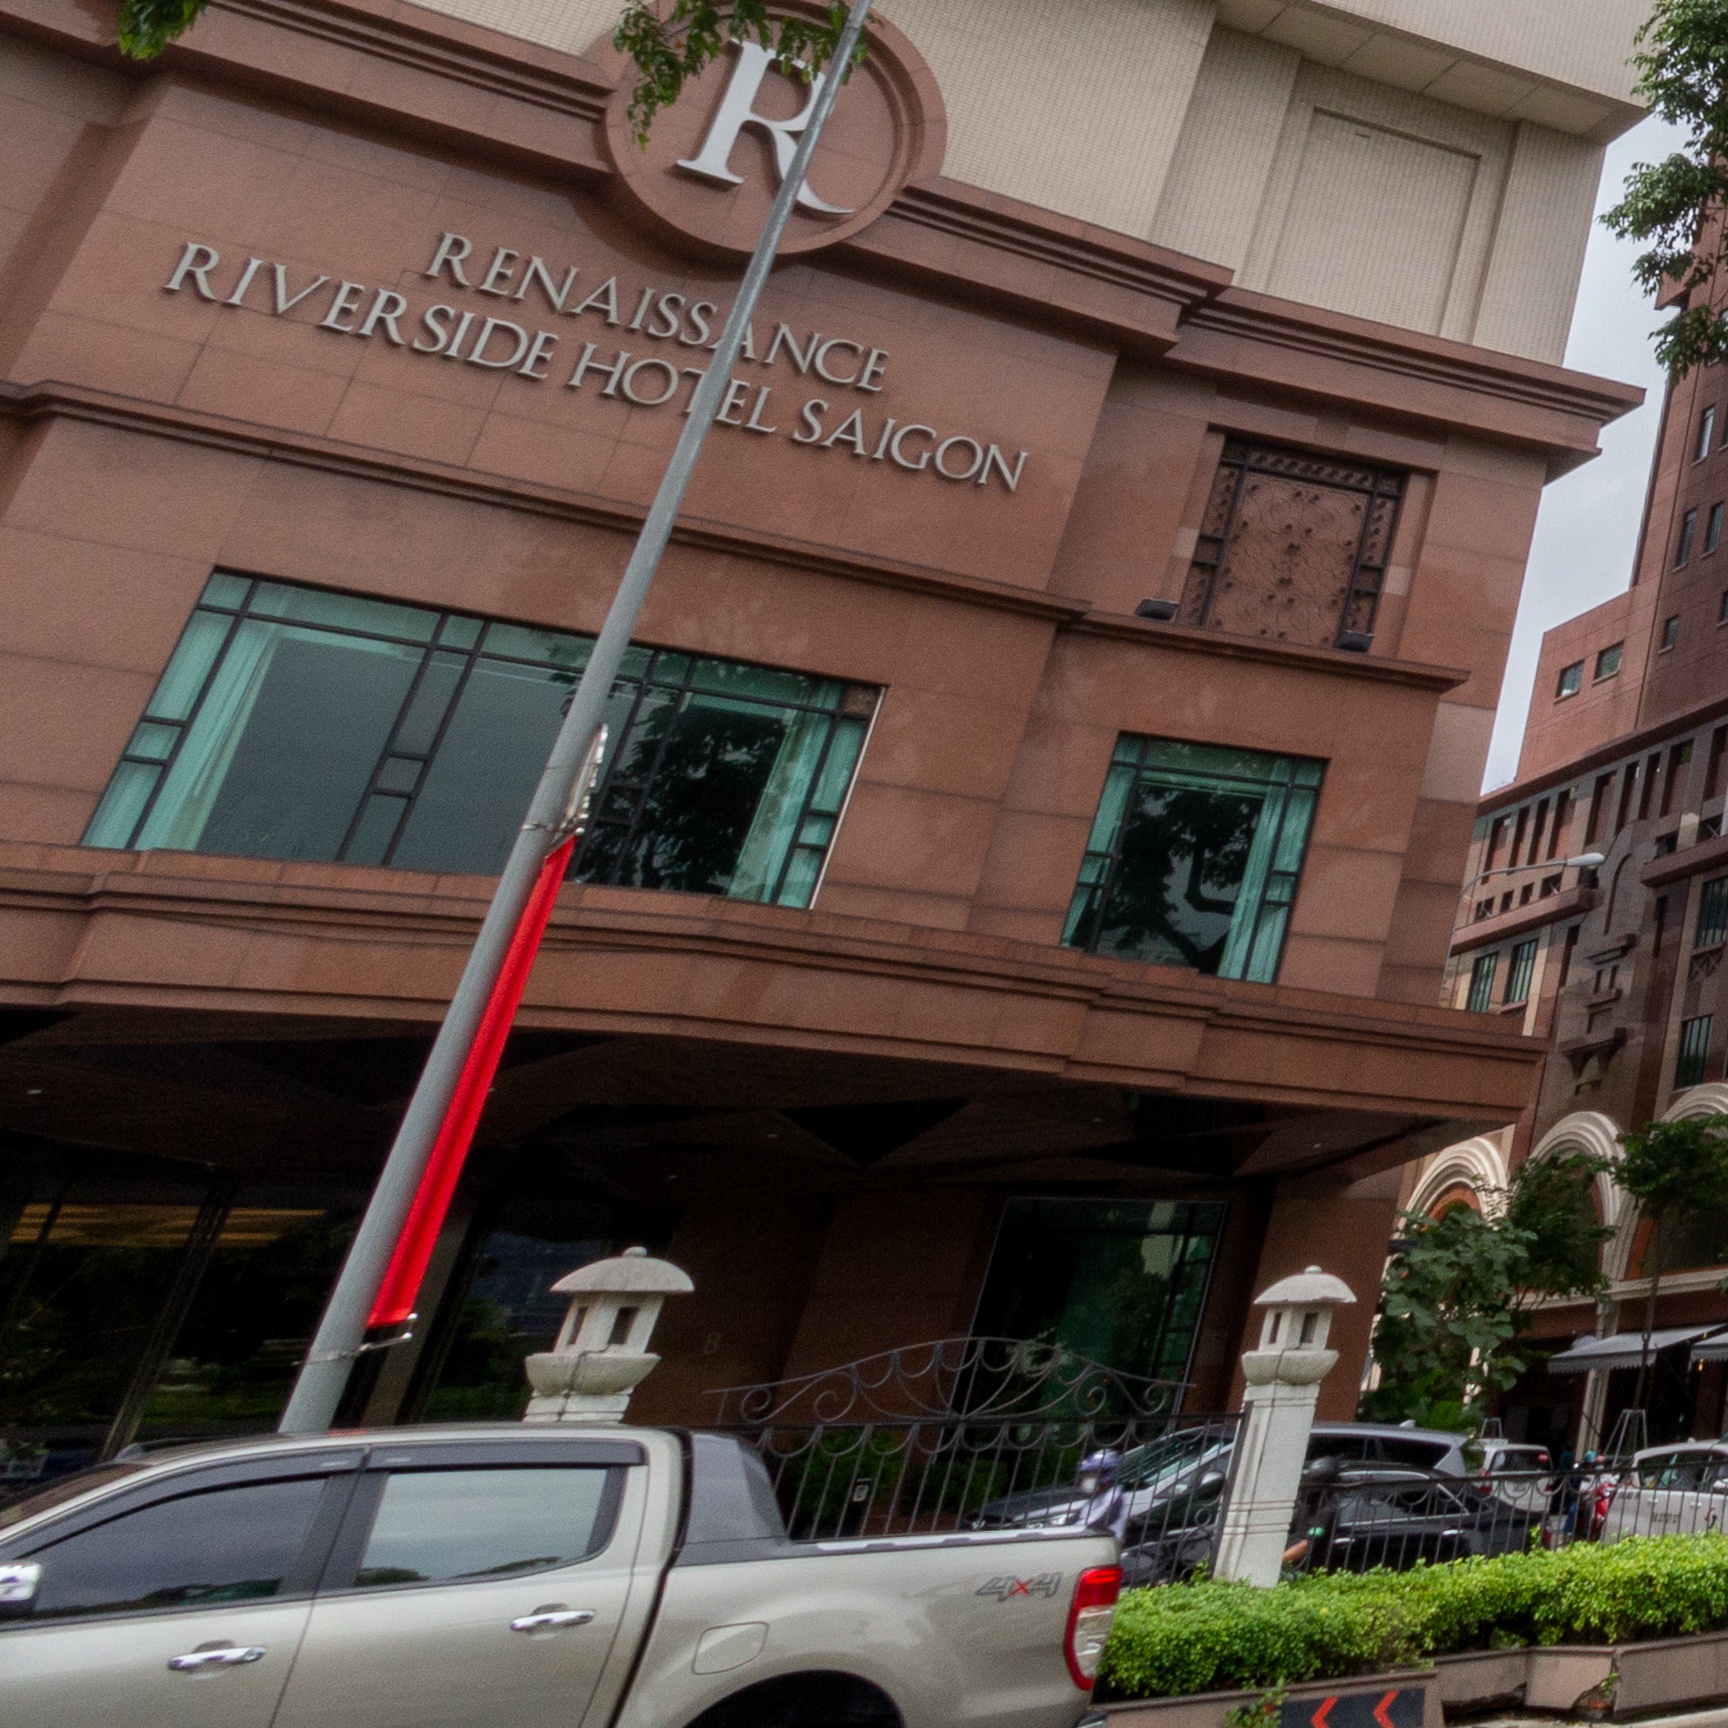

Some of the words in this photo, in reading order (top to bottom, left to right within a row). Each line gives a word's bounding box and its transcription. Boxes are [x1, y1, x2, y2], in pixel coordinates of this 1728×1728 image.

[676, 37, 856, 215] R
[164, 240, 560, 383] RIVERSIDE
[567, 340, 778, 435] HOTEL
[792, 397, 1029, 492] SAIGON
[427, 233, 889, 392] RENAISSANCE
